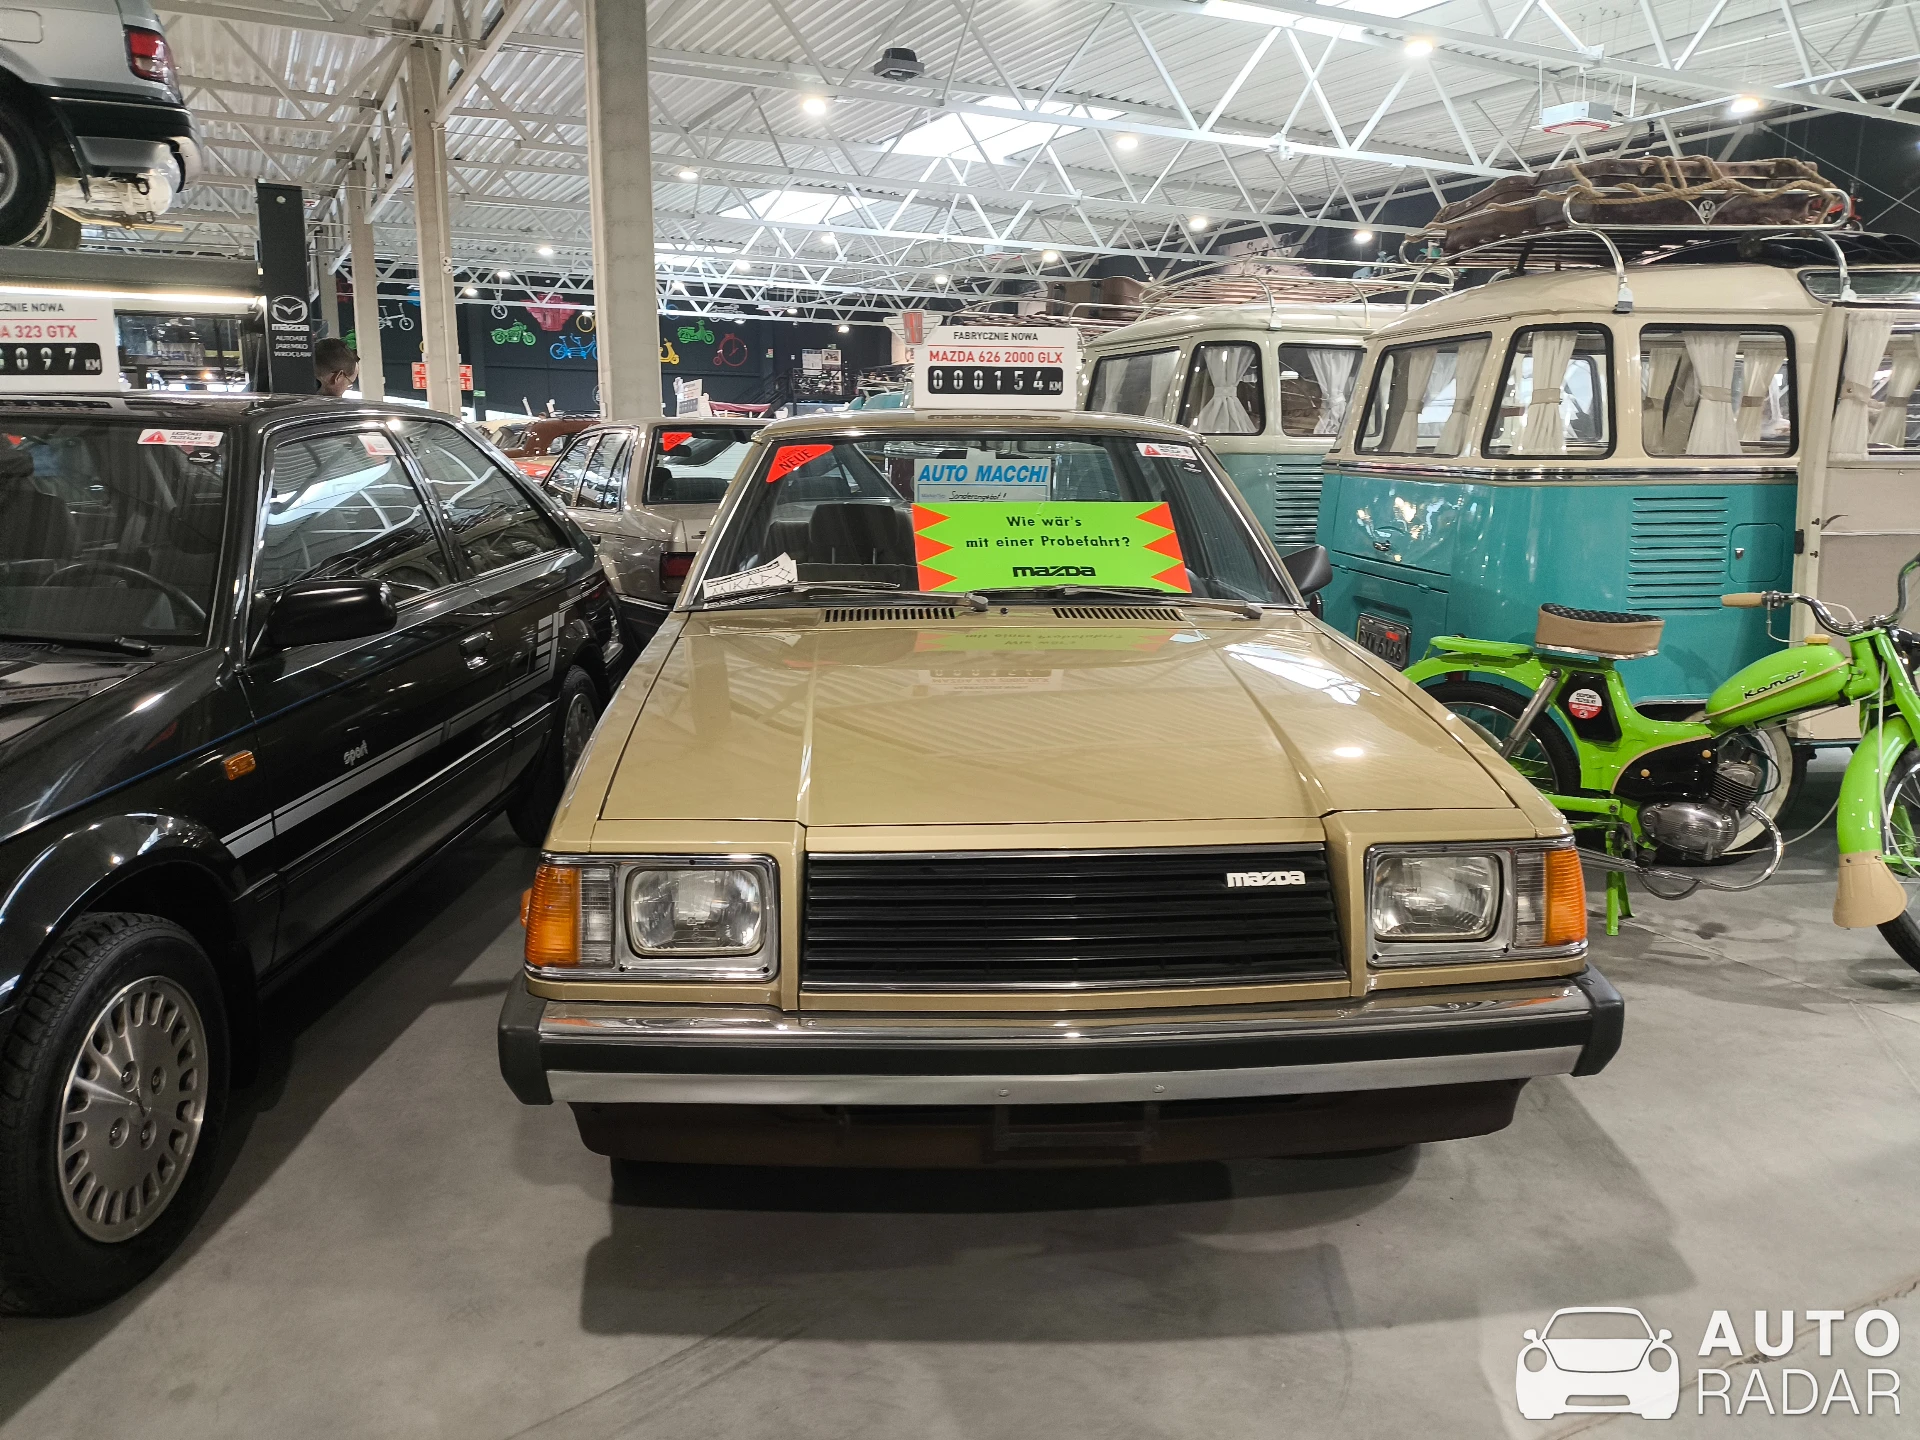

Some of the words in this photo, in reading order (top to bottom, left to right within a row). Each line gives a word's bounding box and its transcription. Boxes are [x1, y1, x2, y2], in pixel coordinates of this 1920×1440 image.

[31, 303, 65, 312] NOWA
[14, 325, 43, 338] 323
[46, 325, 78, 338] GTX
[953, 331, 1009, 341] FABRYCZNIE
[1011, 332, 1038, 341] NOWA
[929, 350, 975, 362] MAZDA
[978, 351, 1001, 363] 626
[1004, 351, 1034, 363] 2000
[1037, 351, 1063, 363] GLX
[1049, 380, 1063, 391] KM
[779, 449, 814, 471] NEUE
[918, 464, 968, 482] AUTO
[975, 465, 1049, 483] MACCHI
[1006, 516, 1035, 527] Wie
[1042, 516, 1082, 527] wär's
[966, 537, 989, 548] mit
[996, 537, 1035, 547] einer
[1040, 535, 1130, 547] Probefahrt?
[1012, 566, 1097, 577] mazda
[1226, 870, 1306, 888] mazda
